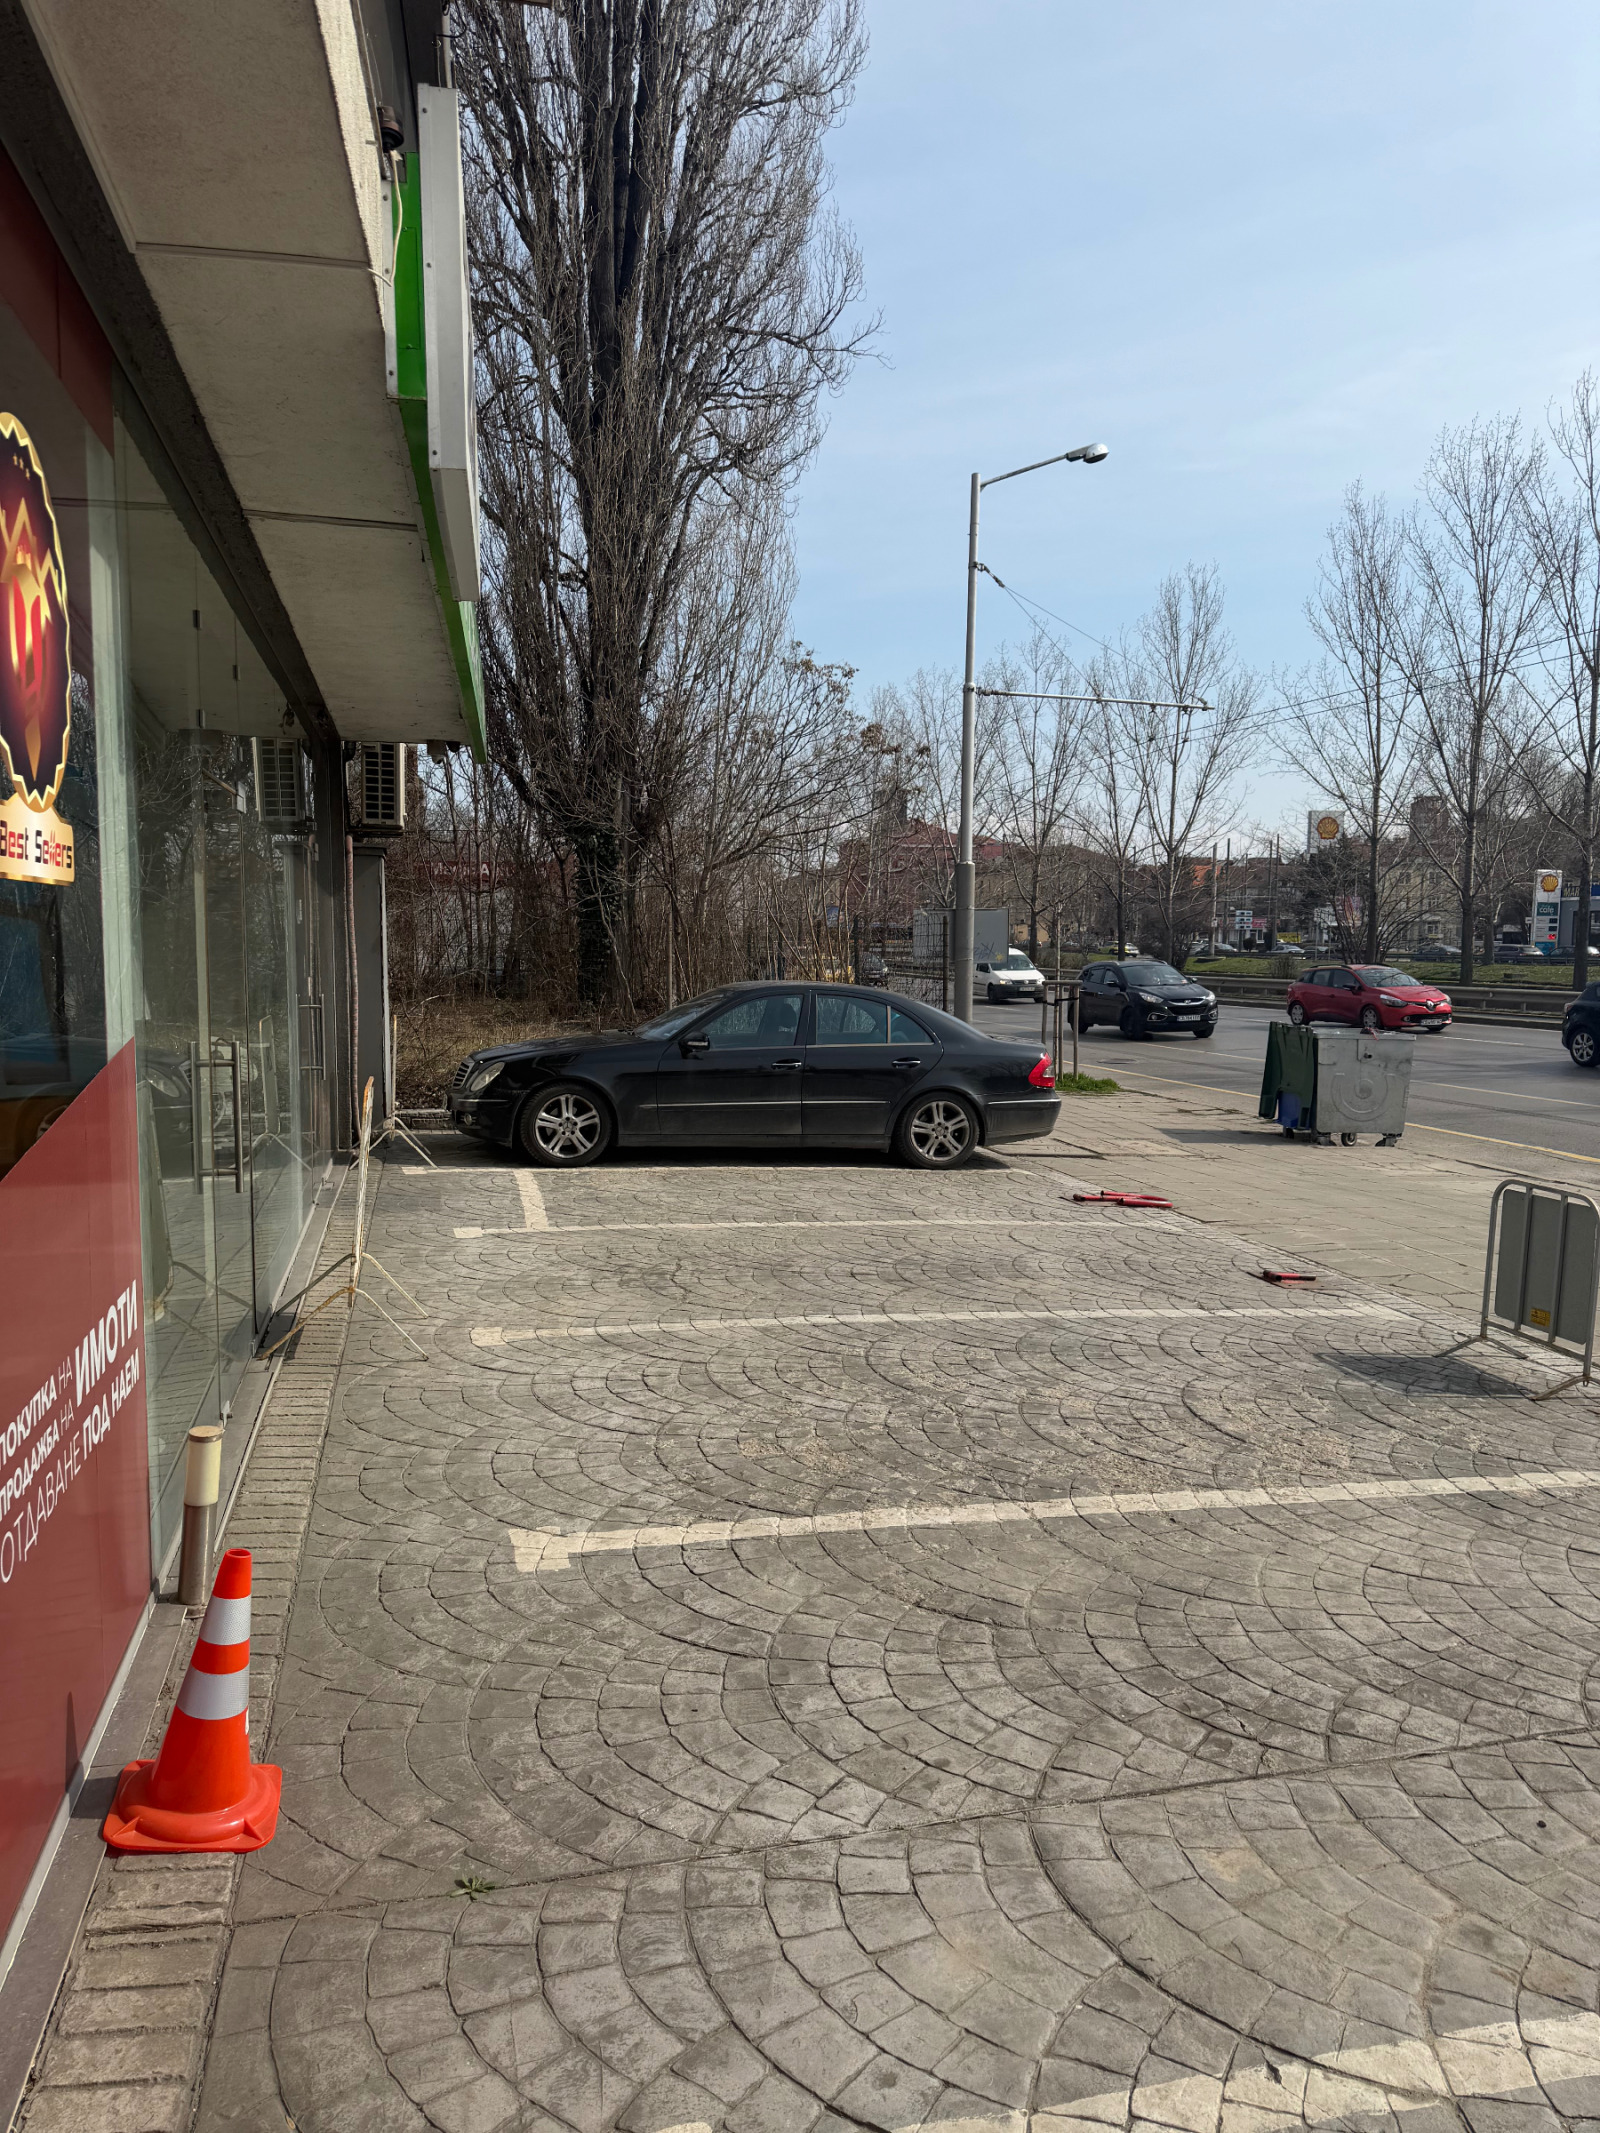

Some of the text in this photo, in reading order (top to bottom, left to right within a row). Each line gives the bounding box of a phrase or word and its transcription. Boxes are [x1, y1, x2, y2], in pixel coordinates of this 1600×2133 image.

[0, 820, 73, 869] Best Sellers
[0, 1279, 138, 1470] ПОКУПКА НА ИМОТИ
[0, 1398, 74, 1521] ПРОДАЖБА НА
[0, 1347, 140, 1583] ОТДАВАНЕ ПОД НАЕМ
